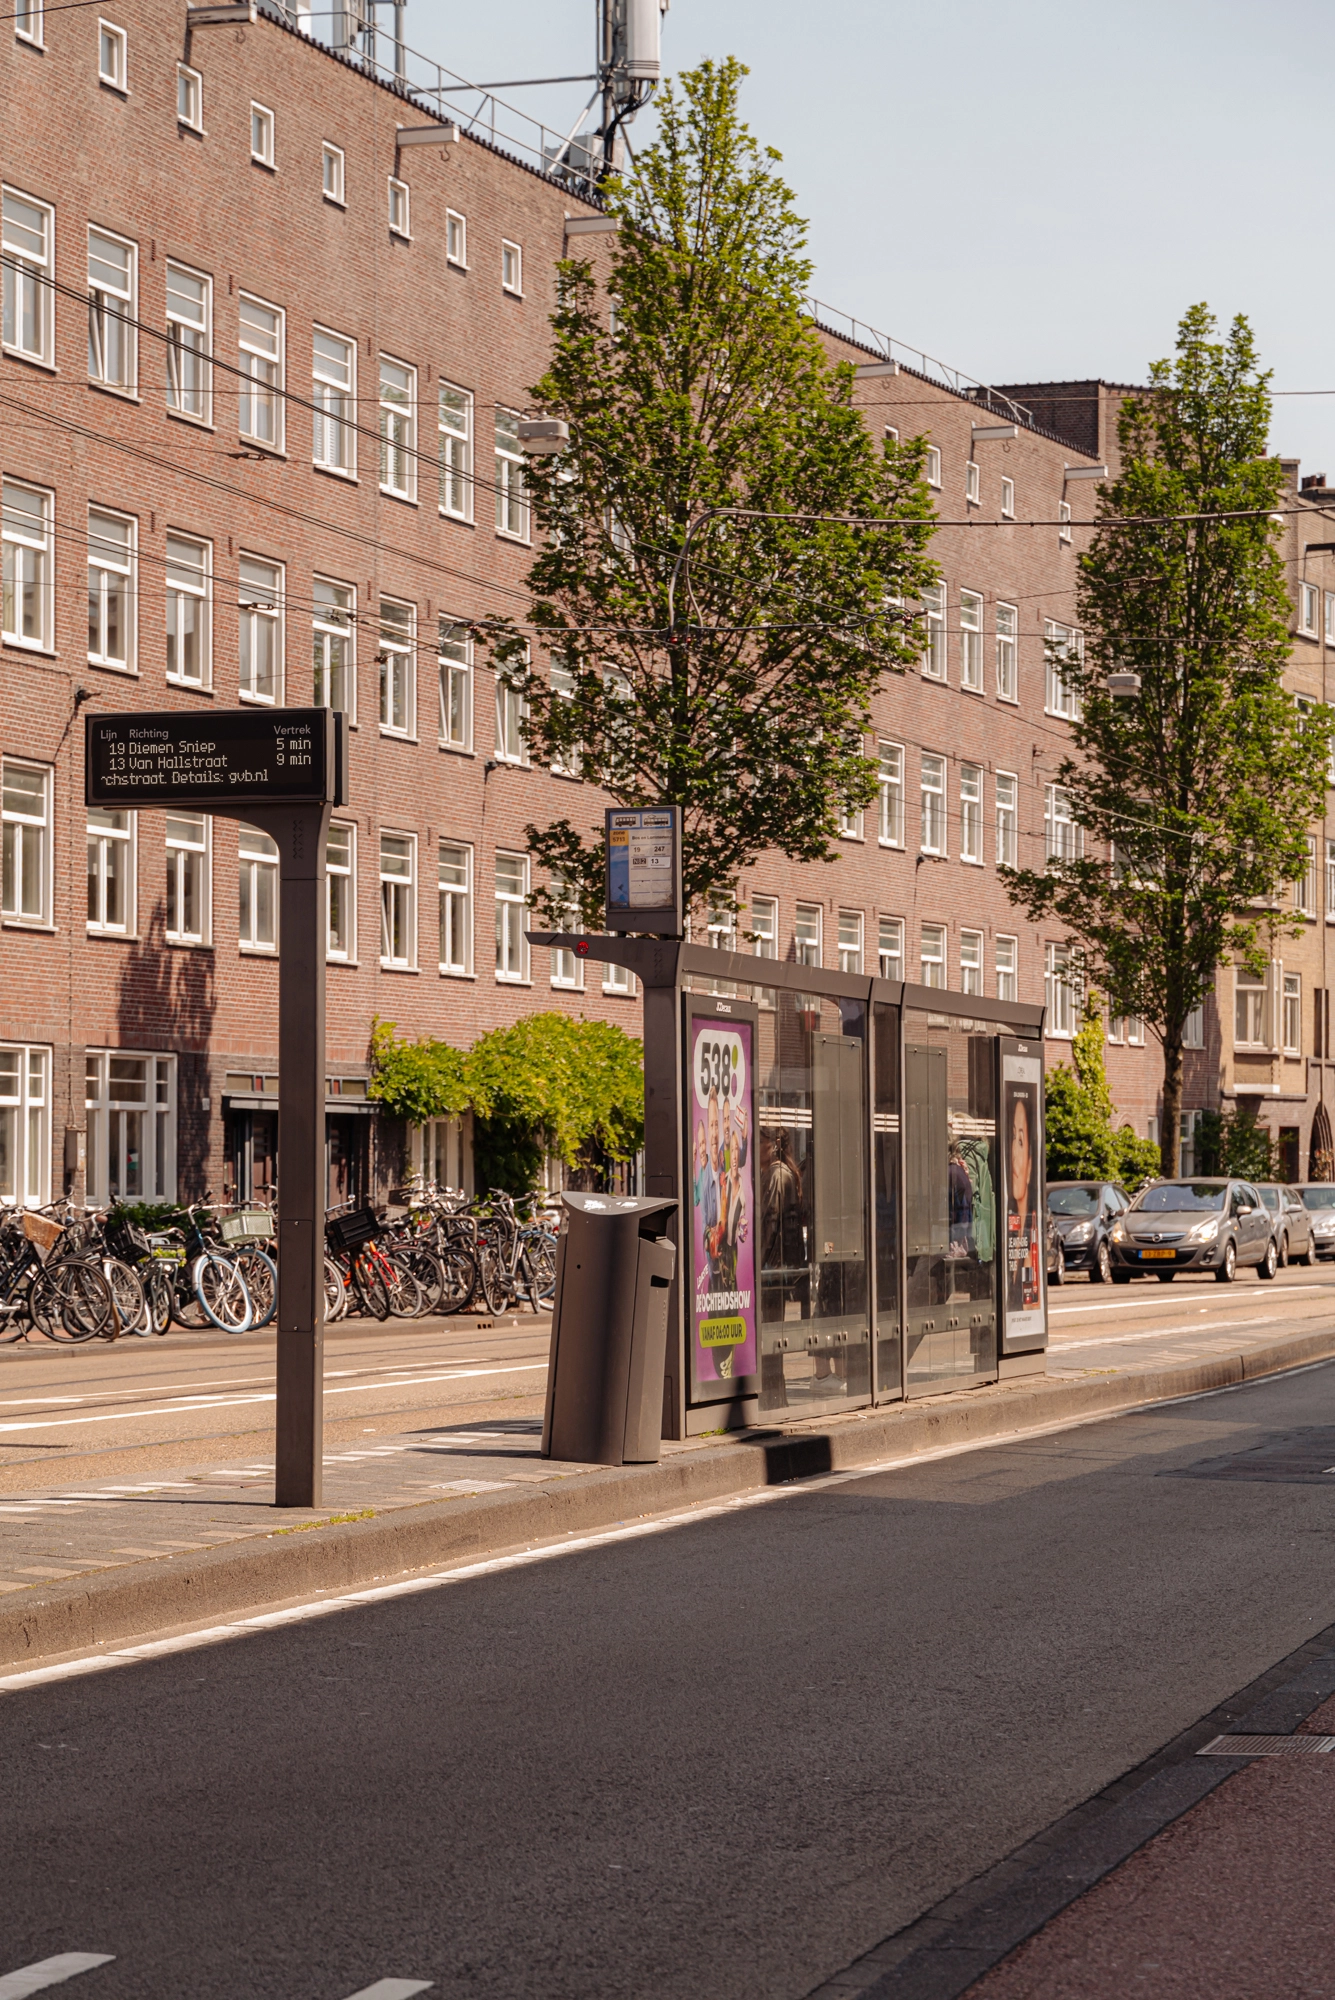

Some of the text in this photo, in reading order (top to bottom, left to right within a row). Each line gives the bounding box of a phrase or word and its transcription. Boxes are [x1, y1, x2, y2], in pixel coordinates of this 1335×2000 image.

[100, 724, 311, 741] Lijn Richting Vertrek
[109, 737, 312, 755] 19 Diemen Sniep 5 min
[109, 752, 312, 770] 13 Van Hallstraat 9 min
[172, 770, 224, 784] Details:
[228, 768, 269, 783] gvb.nl
[700, 1041, 731, 1097] 538
[695, 1290, 751, 1313] DE OCHTENDSHOW
[701, 1323, 743, 1341] VANAF 06:00 UUR
